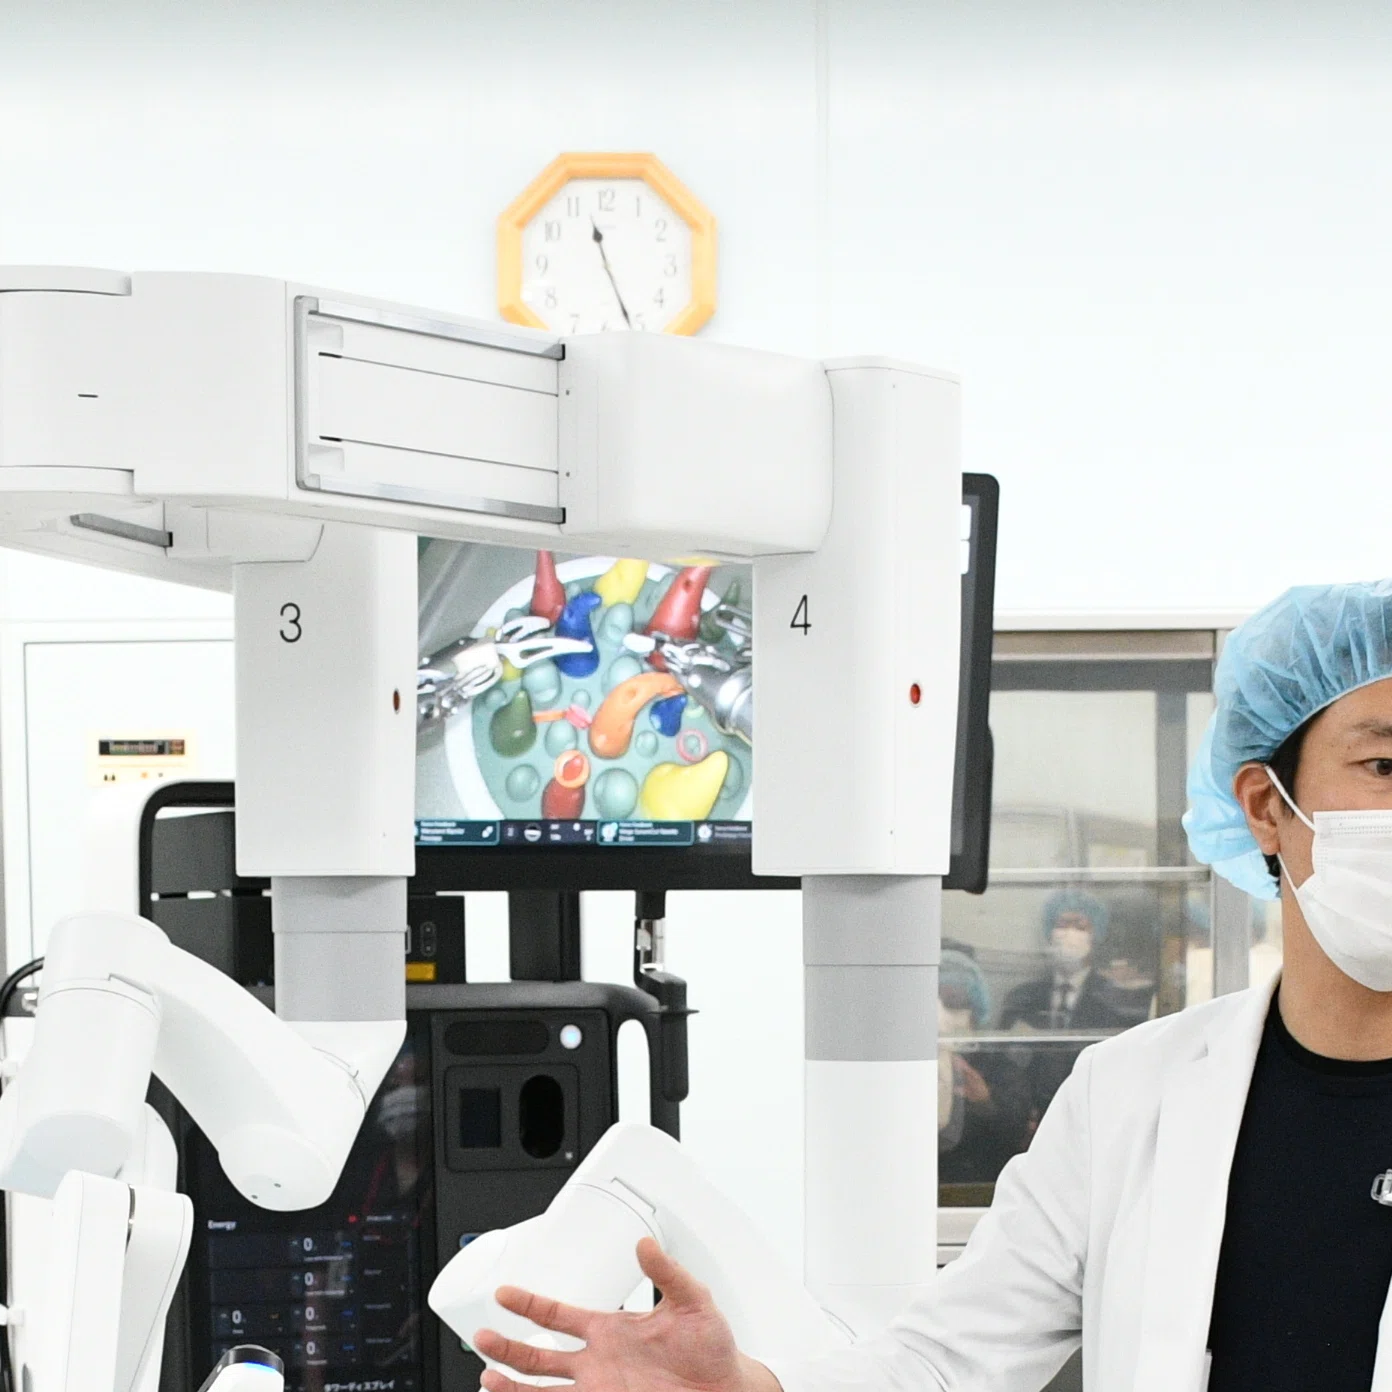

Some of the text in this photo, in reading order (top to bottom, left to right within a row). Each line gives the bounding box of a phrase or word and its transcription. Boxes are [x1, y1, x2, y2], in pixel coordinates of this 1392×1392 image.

[567, 197, 579, 217] 11
[598, 189, 615, 211] 12
[635, 196, 641, 218] 1
[545, 221, 561, 242] 10
[655, 219, 667, 242] 2
[536, 255, 548, 276] 9
[664, 254, 677, 277] 3
[544, 288, 557, 309] 8
[653, 288, 664, 308] 4
[279, 602, 302, 643] 3
[790, 594, 812, 636] 4
